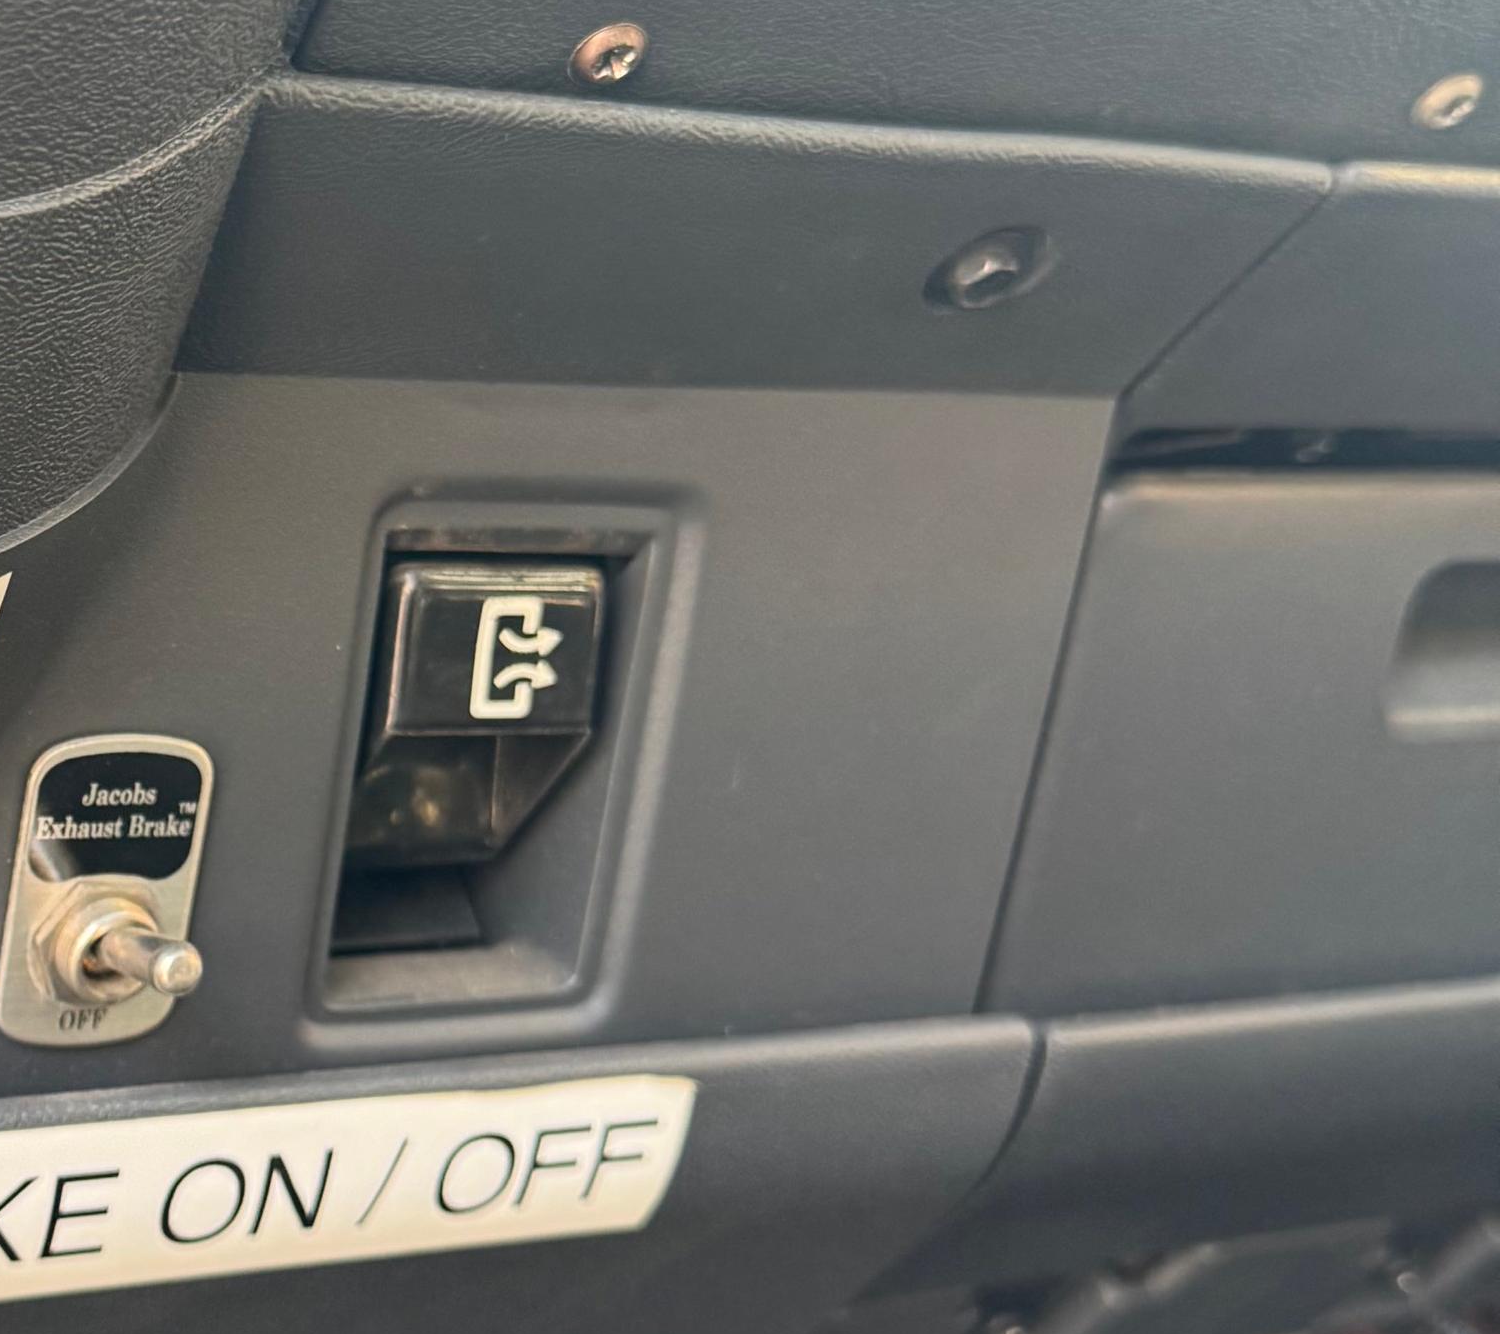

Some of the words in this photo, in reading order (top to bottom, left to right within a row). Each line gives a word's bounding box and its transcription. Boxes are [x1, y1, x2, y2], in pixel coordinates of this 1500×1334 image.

[81, 783, 158, 807] Jacobs
[37, 815, 123, 840] Exhaust
[58, 1005, 108, 1031] OFF
[160, 1148, 334, 1243] ON
[356, 1137, 408, 1226] /
[436, 1119, 658, 1214] OFF
